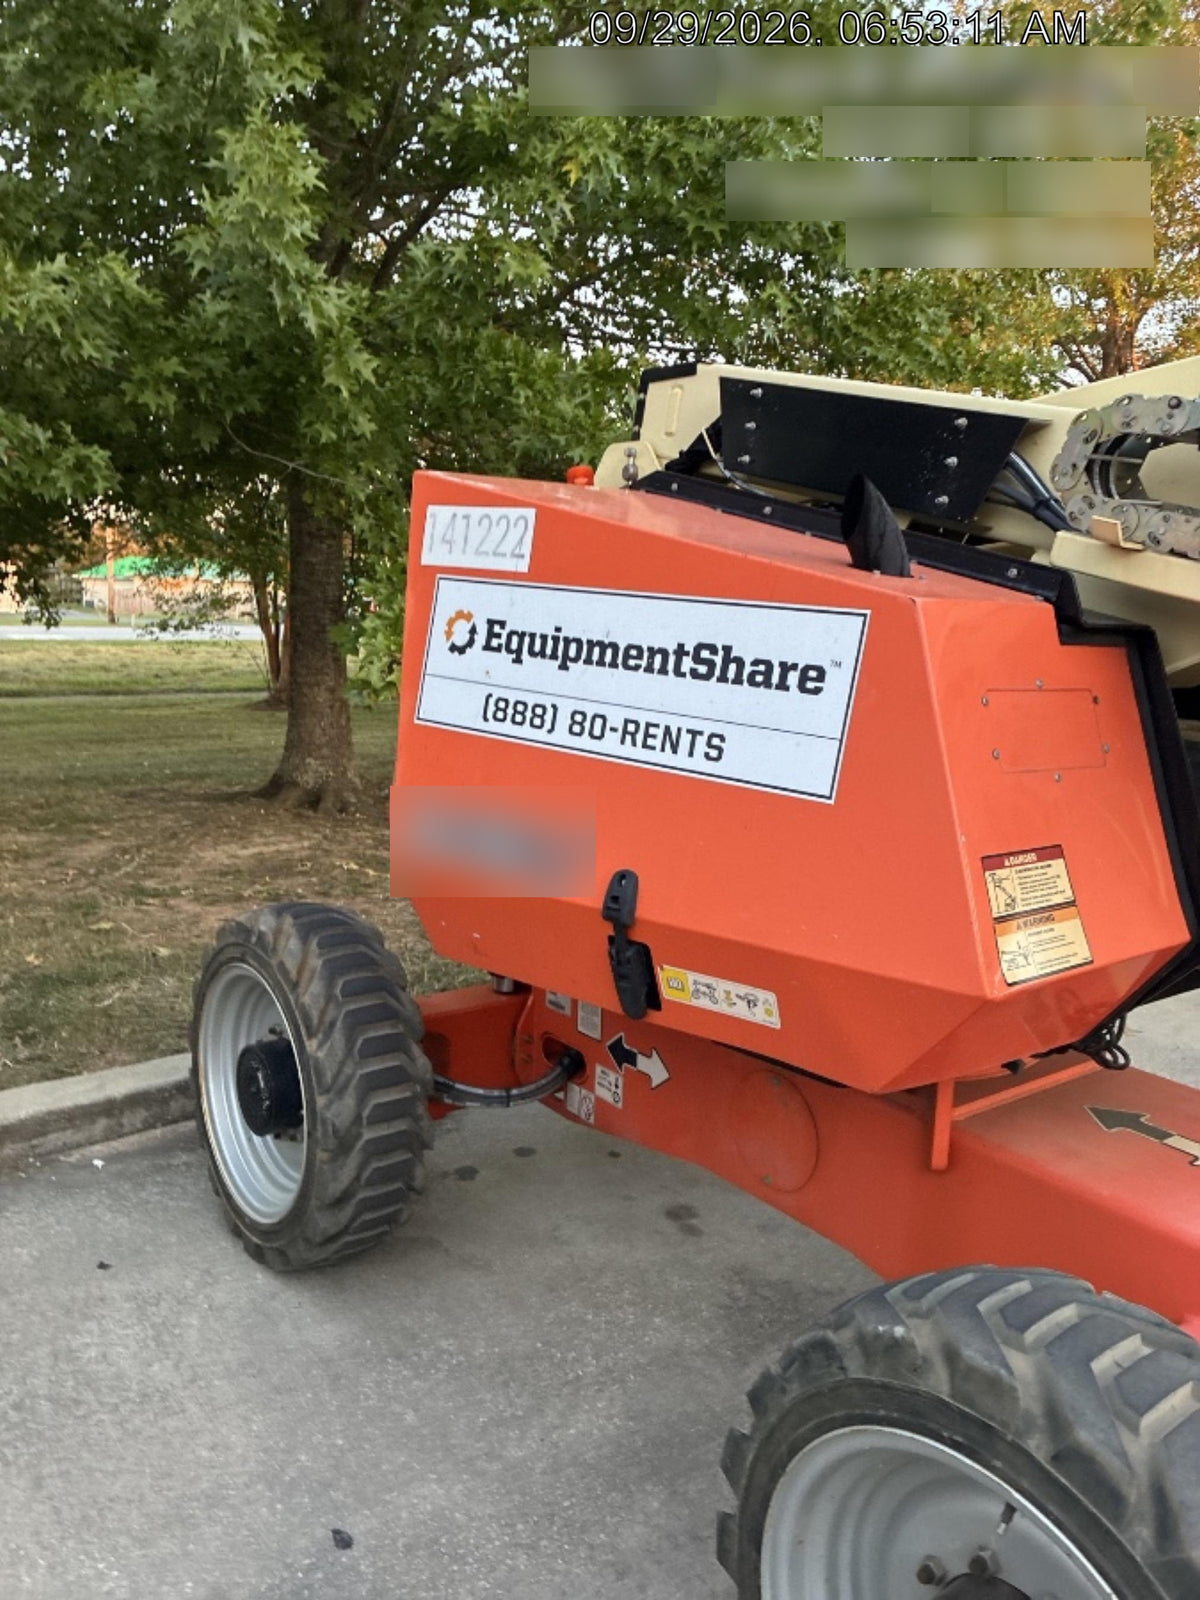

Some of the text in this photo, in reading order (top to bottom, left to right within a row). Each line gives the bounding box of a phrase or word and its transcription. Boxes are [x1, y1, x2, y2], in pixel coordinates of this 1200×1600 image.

[428, 510, 528, 560] 141222
[481, 617, 827, 697] EquipmentShare
[482, 692, 727, 763] (888) 80-RENTS
